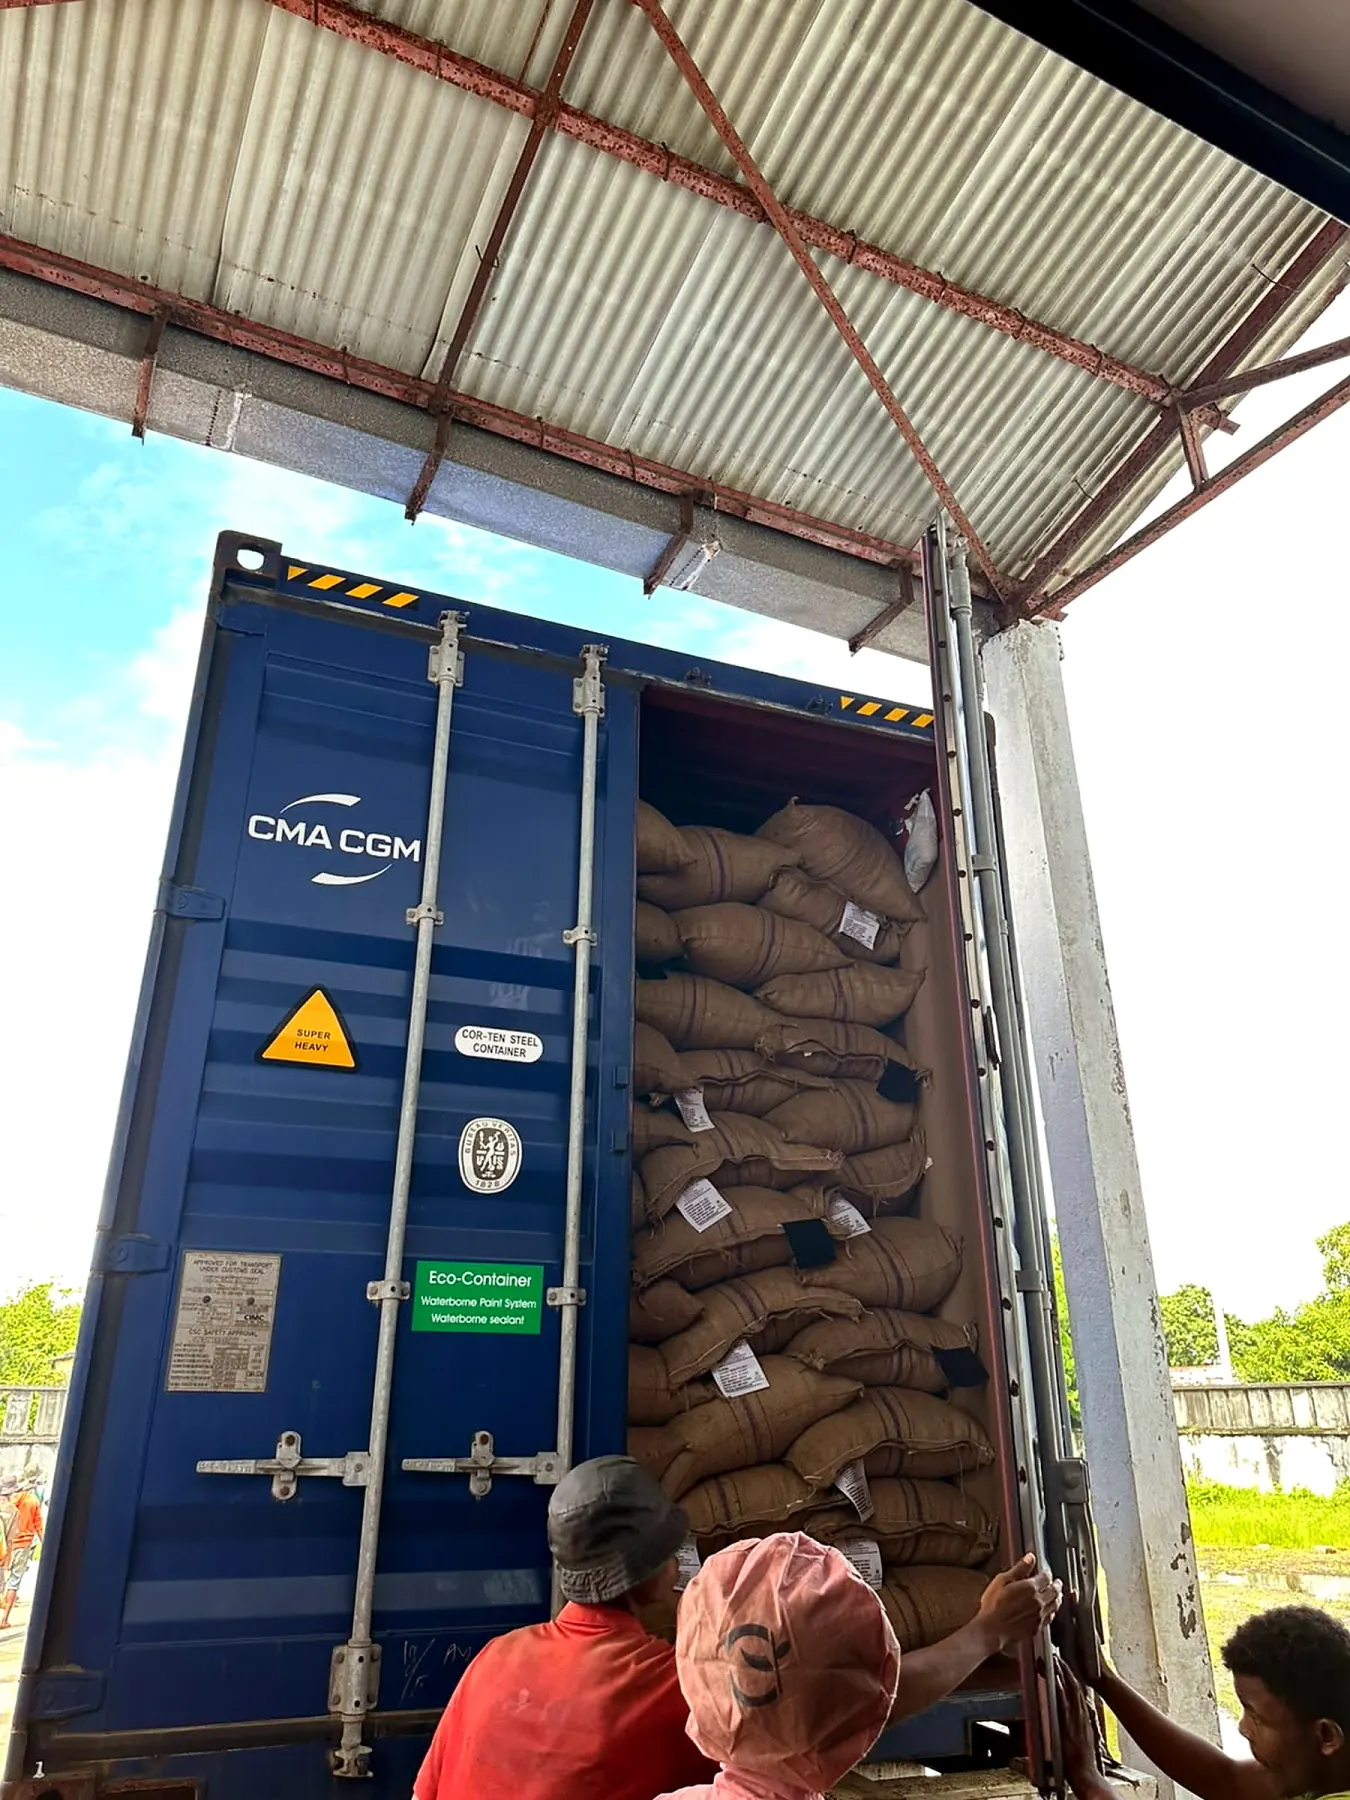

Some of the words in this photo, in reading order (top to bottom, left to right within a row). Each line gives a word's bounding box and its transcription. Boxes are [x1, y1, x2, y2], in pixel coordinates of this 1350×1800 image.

[248, 814, 333, 850] CMA
[339, 829, 422, 862] CGM
[296, 1028, 331, 1040] SUPER
[461, 1028, 506, 1043] COR-TEN
[509, 1034, 539, 1047] STEEL
[294, 1041, 329, 1052] HEAVY
[472, 1042, 527, 1058] CONTAINER
[464, 1121, 488, 1154] BUREAU
[492, 1121, 517, 1156] VERITAS
[475, 1180, 500, 1188] 1828
[193, 1259, 224, 1267] APPROVED
[428, 1270, 532, 1287] Eco-Container
[420, 1295, 477, 1307] Waterborne
[479, 1297, 502, 1308] Paint
[504, 1298, 537, 1310] System
[431, 1313, 487, 1324] Waterborne
[489, 1315, 525, 1325] sealant
